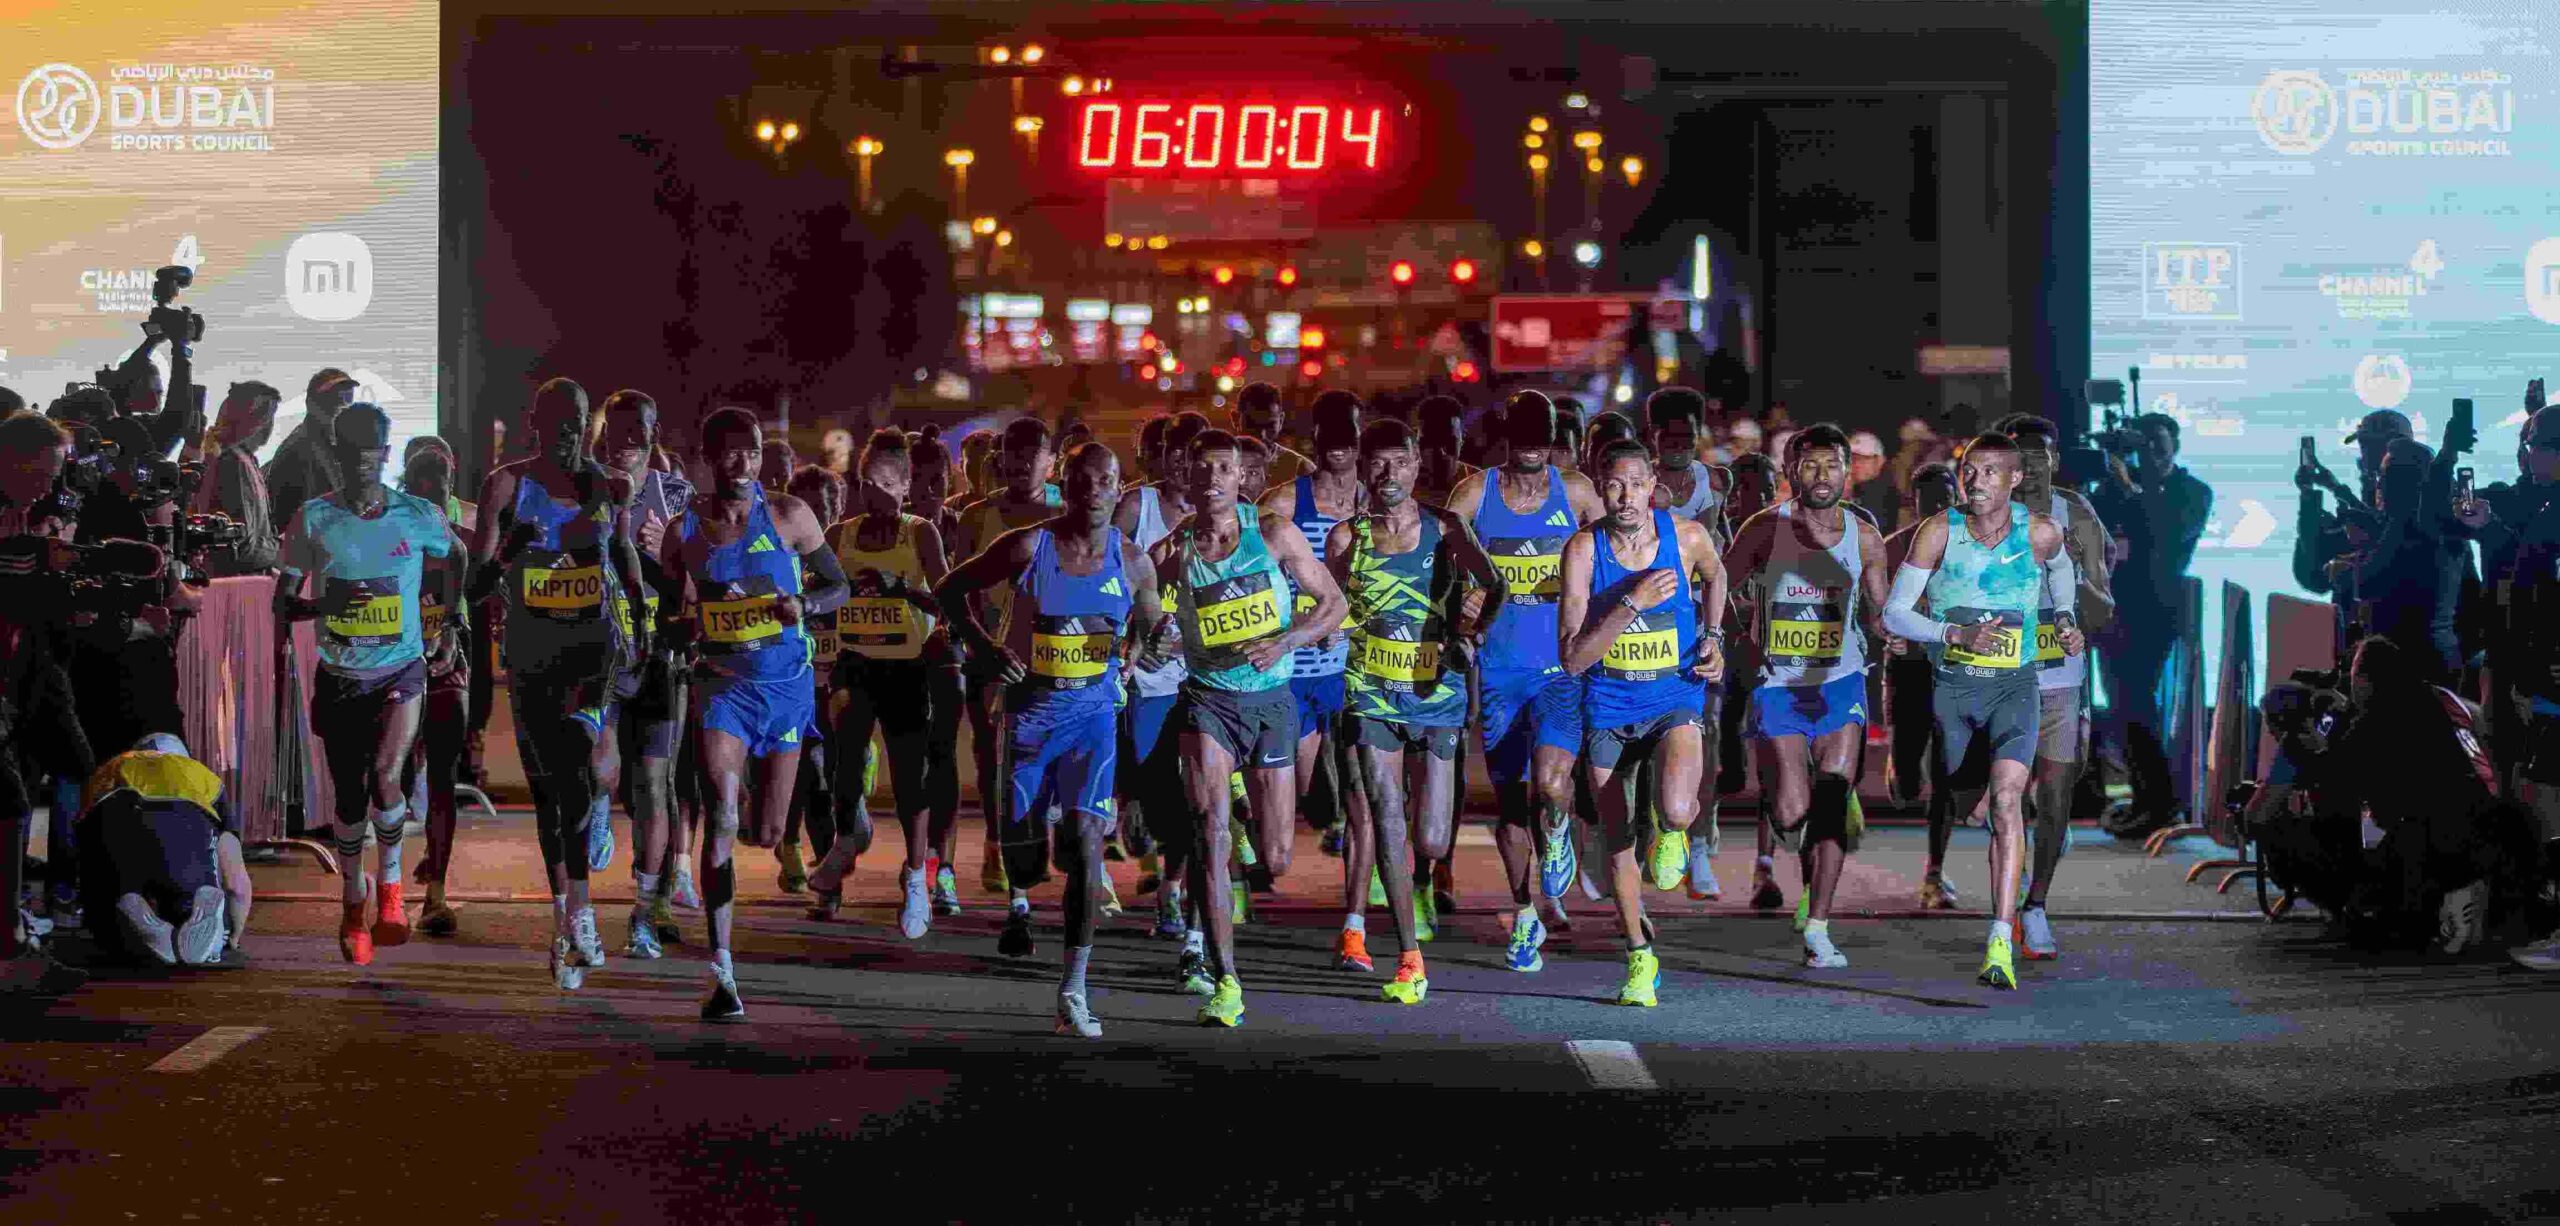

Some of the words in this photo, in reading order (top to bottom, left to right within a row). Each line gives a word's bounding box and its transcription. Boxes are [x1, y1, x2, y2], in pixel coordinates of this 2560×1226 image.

[111, 86, 274, 127] DUBAI
[2347, 89, 2512, 133] DUBAI
[111, 134, 185, 150] SPORTS
[192, 134, 274, 150] COUNCIL
[1080, 104, 1381, 168] 06:00:04
[172, 234, 205, 275] 4
[2410, 239, 2444, 280] 4
[2156, 249, 2231, 284] ITP
[2319, 276, 2427, 296] CHANNEL
[529, 575, 599, 597] KIPTOO
[841, 606, 902, 624] BEYENE
[1203, 600, 1276, 637] DESISA
[1609, 640, 1673, 661] GIRMA
[1775, 630, 1839, 649] MOGES
[1036, 645, 1108, 663] KIPKOECH
[1368, 646, 1433, 669] ATINAFU
